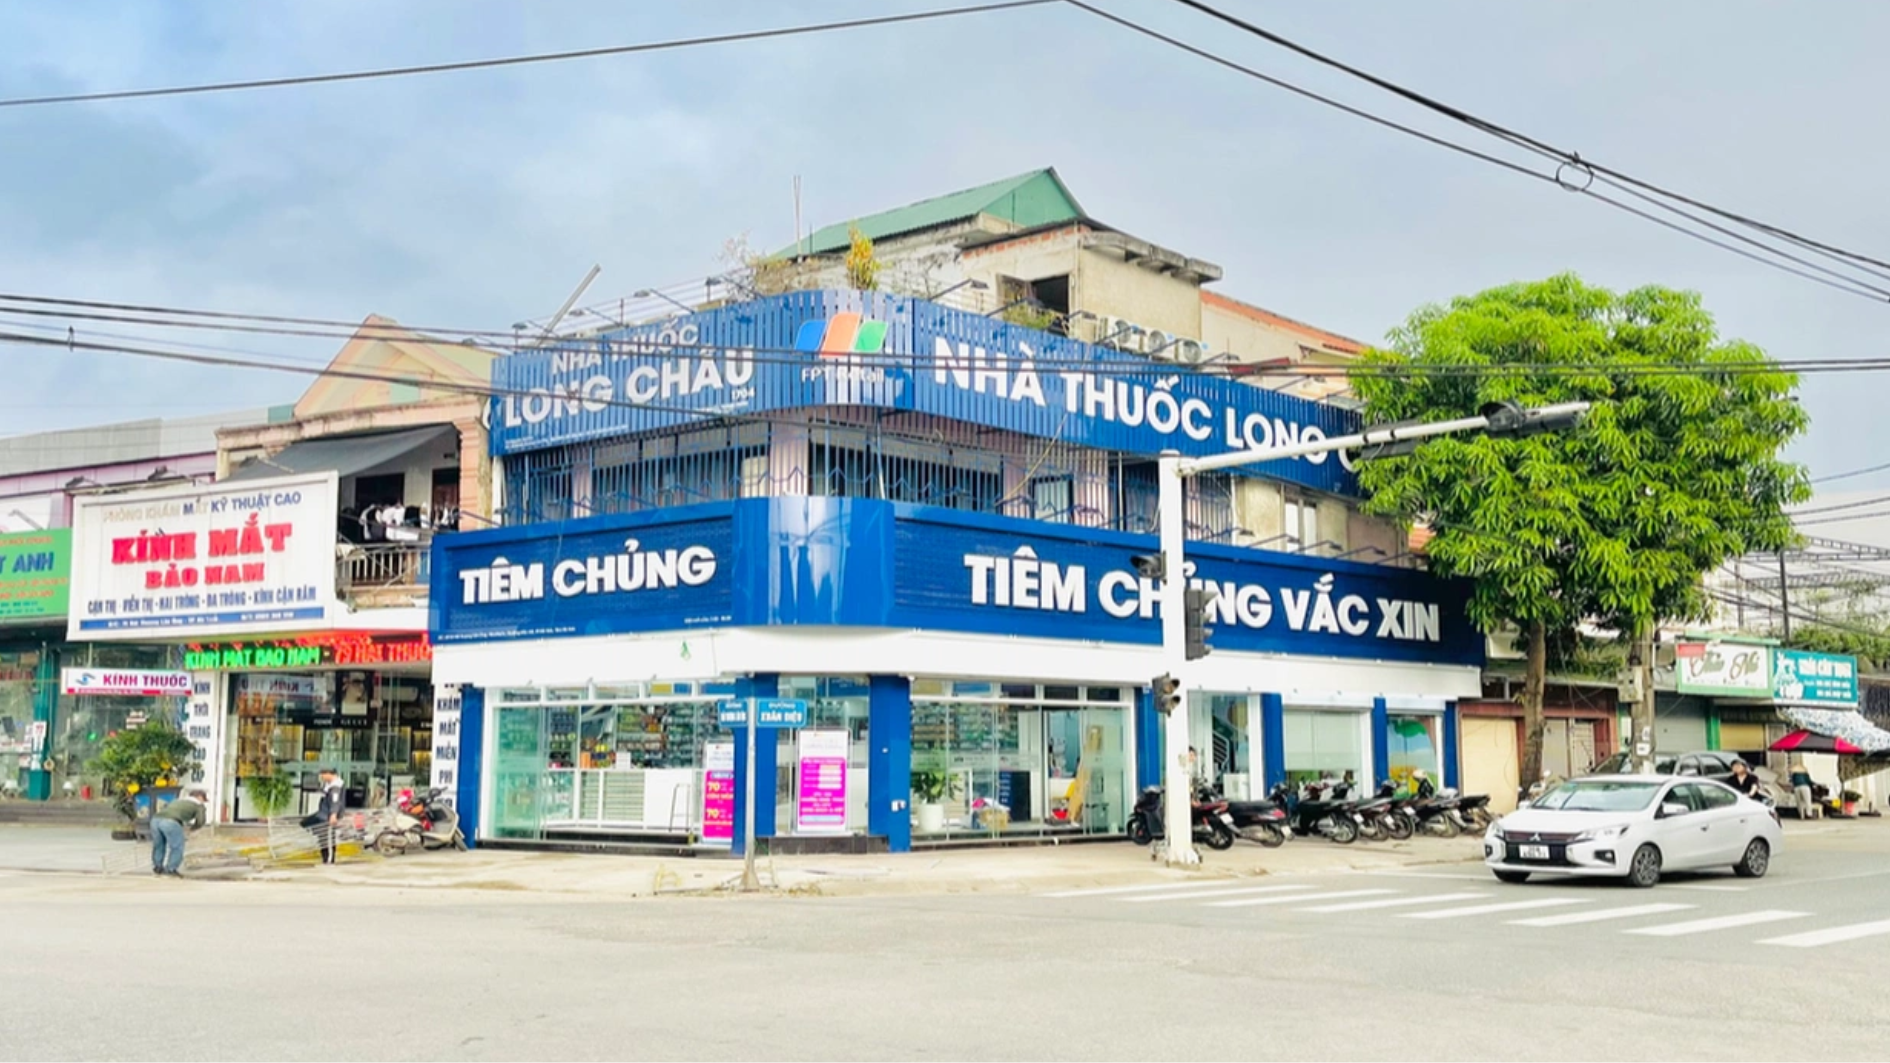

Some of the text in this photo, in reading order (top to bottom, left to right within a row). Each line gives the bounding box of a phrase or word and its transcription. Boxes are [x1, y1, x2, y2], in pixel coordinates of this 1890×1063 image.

[505, 374, 613, 428] LONG
[626, 343, 754, 404] CHÂU
[801, 367, 833, 383] FPT
[934, 336, 1046, 407] NHÀ
[1060, 374, 1213, 441] THUỐC
[233, 493, 271, 513] THUẬT
[274, 491, 301, 506] CAO
[111, 512, 293, 565] KÍNH MẮT
[12, 551, 54, 574] ANH
[145, 562, 265, 590] BẢO NAM
[459, 538, 717, 605] TIÊM CHỦNG
[964, 547, 1440, 642] TIÊM CHNG VẮC XIN
[103, 671, 188, 687] KÍNH THUỐC
